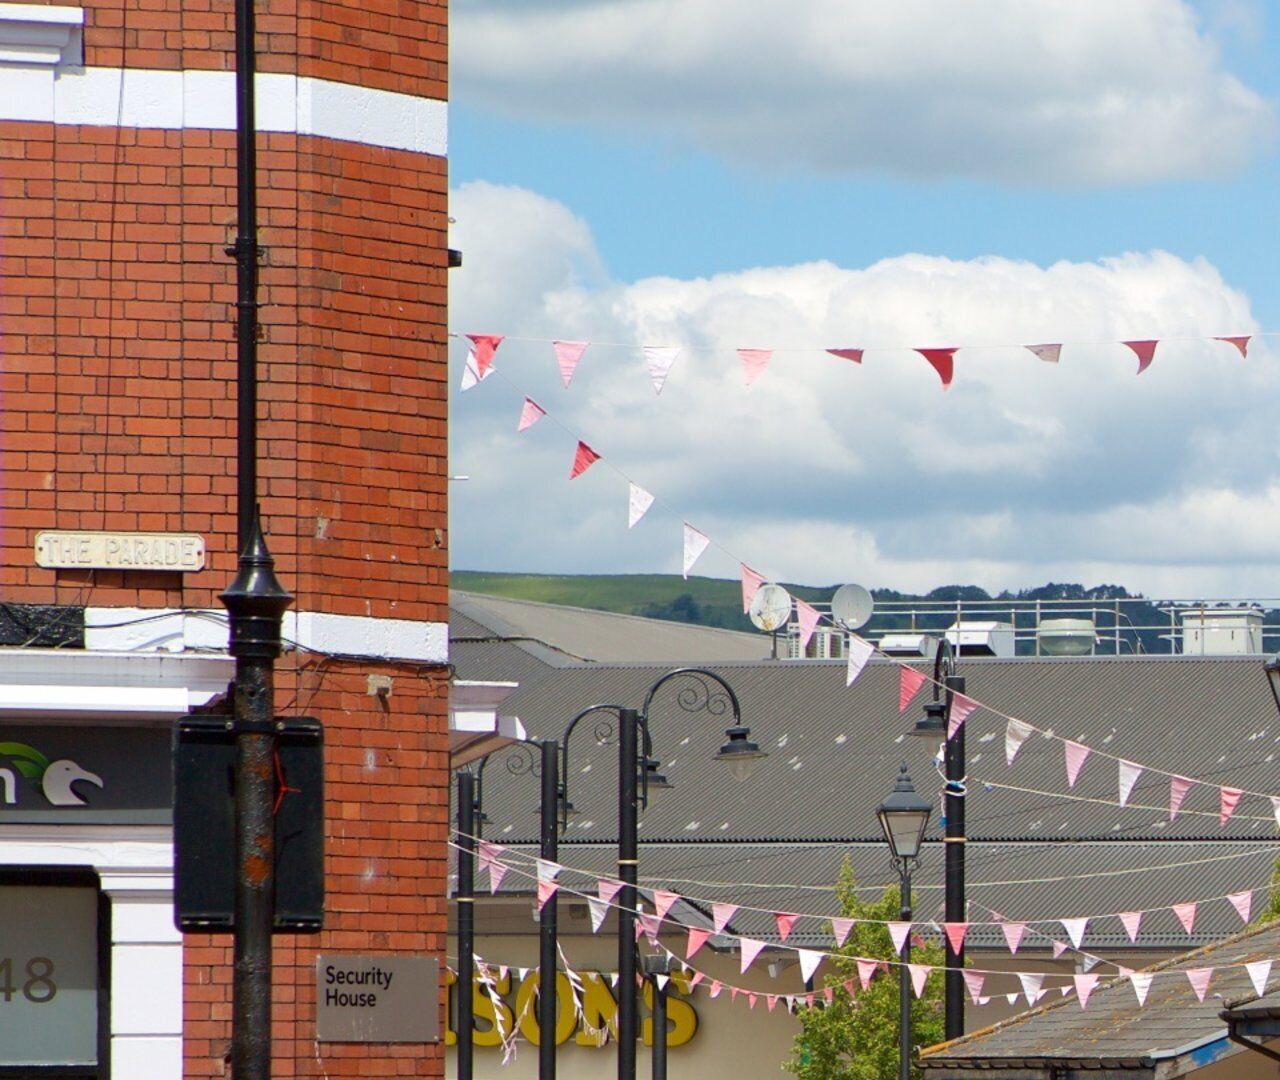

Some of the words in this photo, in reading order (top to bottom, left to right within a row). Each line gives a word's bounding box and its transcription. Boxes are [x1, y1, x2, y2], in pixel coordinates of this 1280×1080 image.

[43, 538, 92, 564] THE
[105, 537, 196, 566] PARADE
[326, 965, 393, 990] Security
[326, 988, 377, 1007] House
